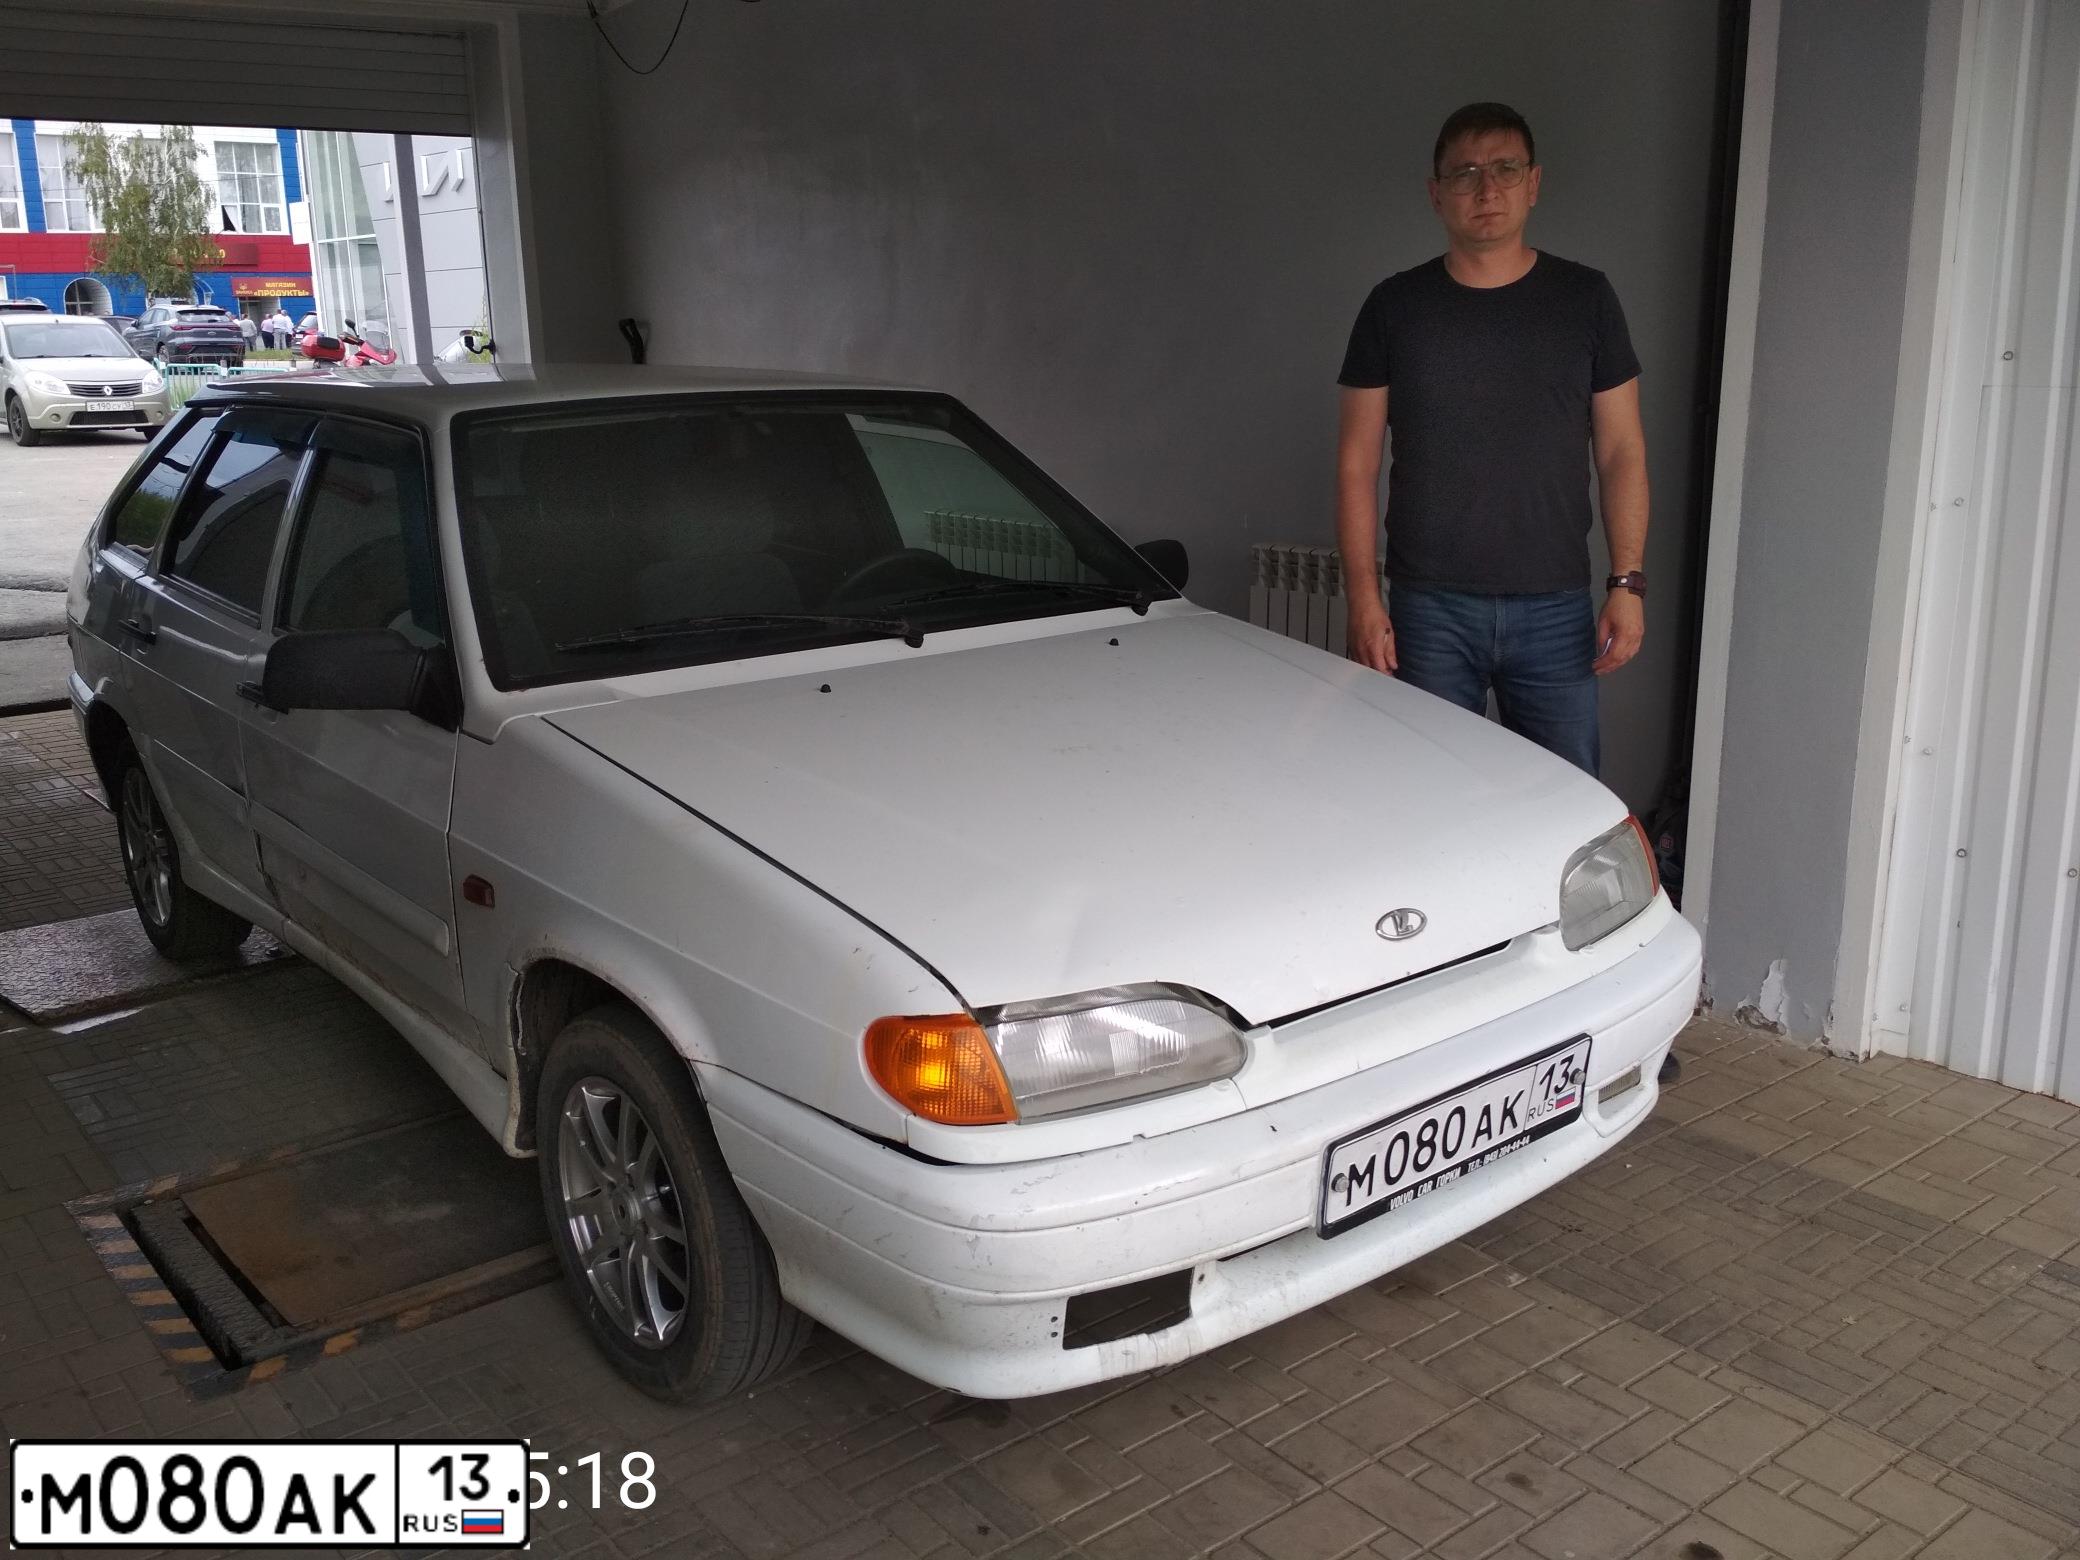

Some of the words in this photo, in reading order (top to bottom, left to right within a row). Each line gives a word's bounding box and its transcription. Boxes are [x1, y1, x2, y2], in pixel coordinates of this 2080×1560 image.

[1346, 1089, 1525, 1206] М080АК
[1539, 1054, 1575, 1100] 13
[1527, 1098, 1554, 1123] RUS
[1390, 1189, 1415, 1211] VOLVO
[1417, 1180, 1434, 1198] CAR
[1436, 1166, 1462, 1188] ГОРКИ
